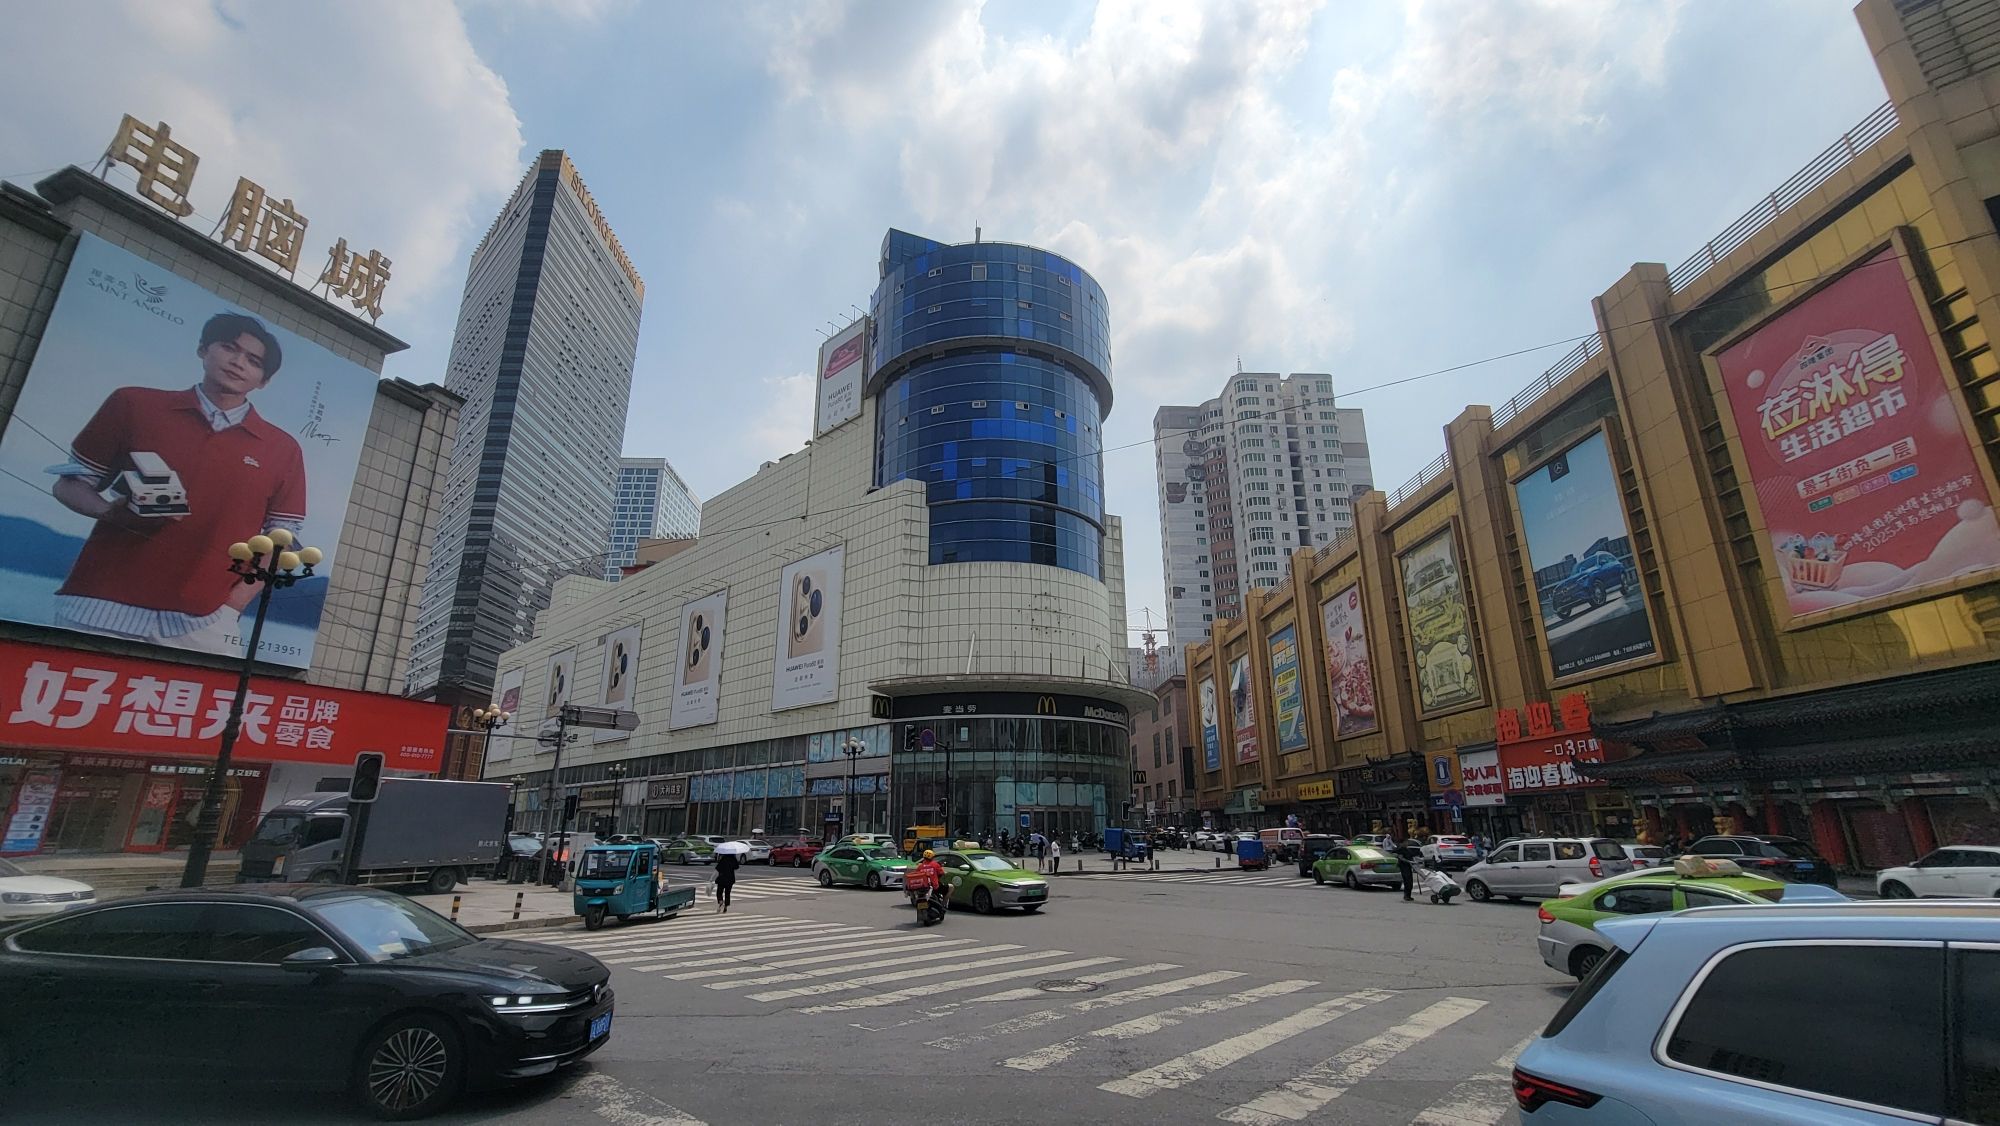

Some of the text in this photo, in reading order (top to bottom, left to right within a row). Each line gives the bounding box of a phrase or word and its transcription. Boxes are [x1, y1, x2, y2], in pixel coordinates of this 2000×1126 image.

[107, 112, 392, 320] 电脑城
[87, 277, 184, 325] SAINT ANGELO
[828, 381, 853, 400] HUAWEI
[1757, 333, 1906, 440] 莅淋得
[1780, 386, 1907, 463] 生活超市
[1802, 439, 1913, 496] 景子街负一层
[8, 661, 274, 745] 好想来
[280, 696, 340, 724] 品牌
[943, 704, 977, 713] 麦当劳
[274, 721, 337, 751] 零食
